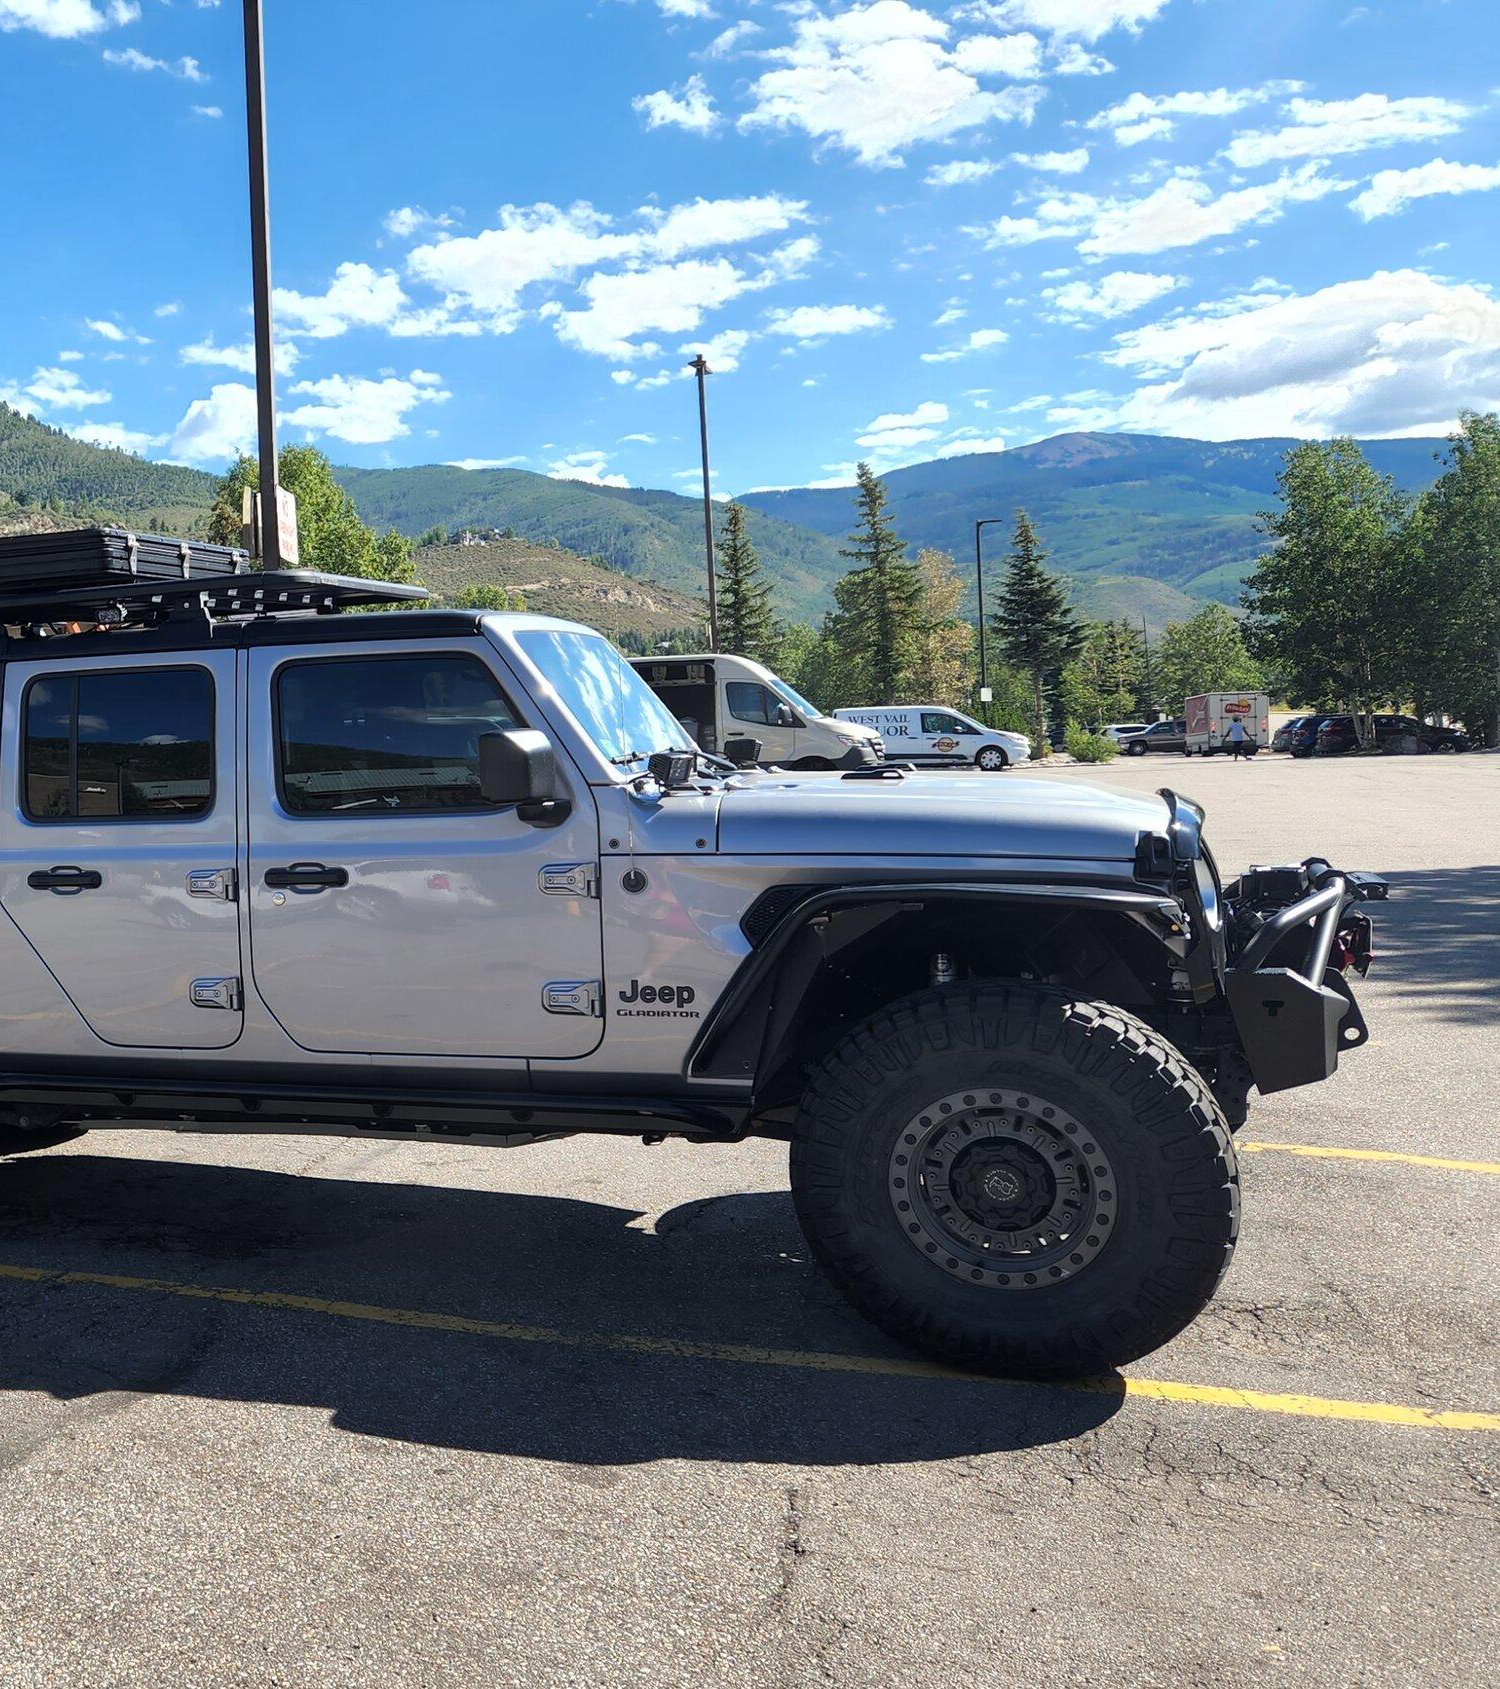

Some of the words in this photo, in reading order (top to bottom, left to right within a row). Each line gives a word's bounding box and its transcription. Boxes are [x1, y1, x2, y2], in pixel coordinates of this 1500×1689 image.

[848, 715, 879, 724] WEST
[884, 714, 910, 723] VAIL
[873, 725, 910, 737] UOR
[619, 979, 695, 1008] Jeep
[616, 1008, 700, 1018] GLADIATOR
